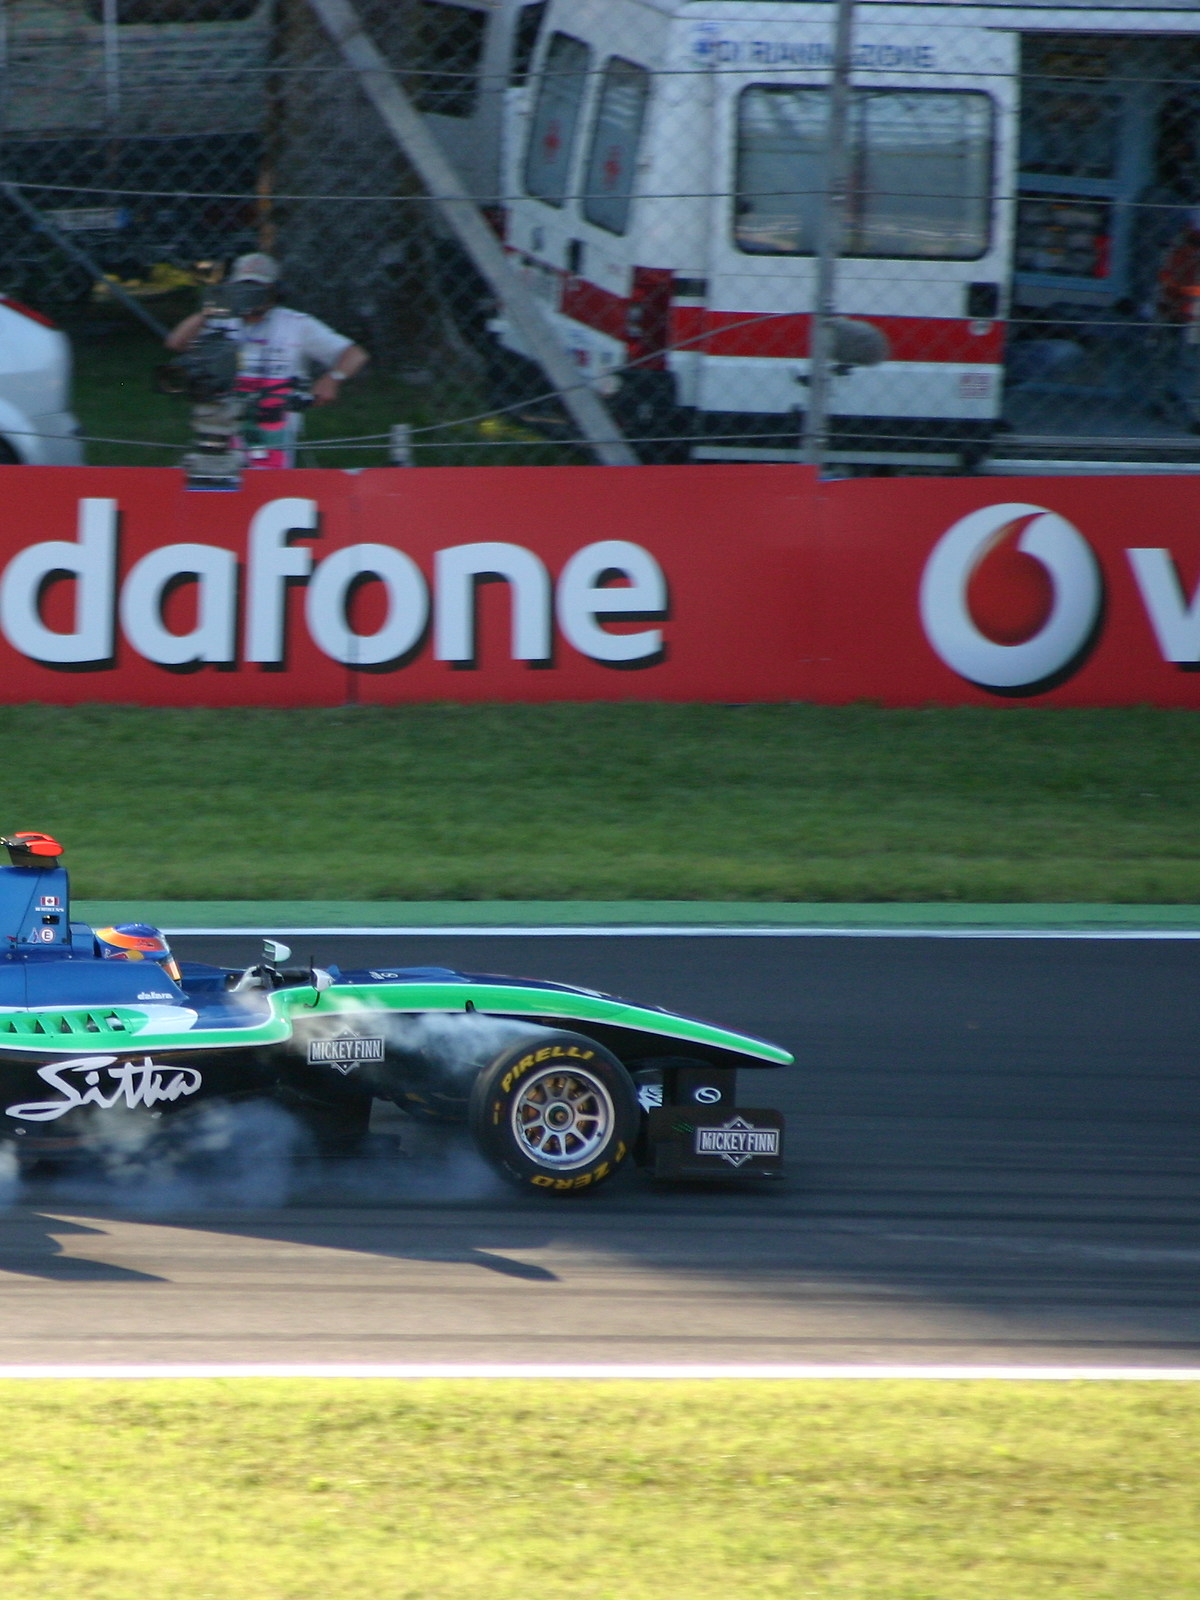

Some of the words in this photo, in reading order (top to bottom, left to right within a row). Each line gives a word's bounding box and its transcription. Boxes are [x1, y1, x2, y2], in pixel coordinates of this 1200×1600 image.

[312, 1041, 353, 1060] MICKEY
[354, 1040, 381, 1058] FINN
[501, 1046, 595, 1093] PIRELLI
[701, 1132, 745, 1150] MICKEY
[747, 1133, 775, 1151] FINN
[530, 1162, 610, 1189] ZERO
